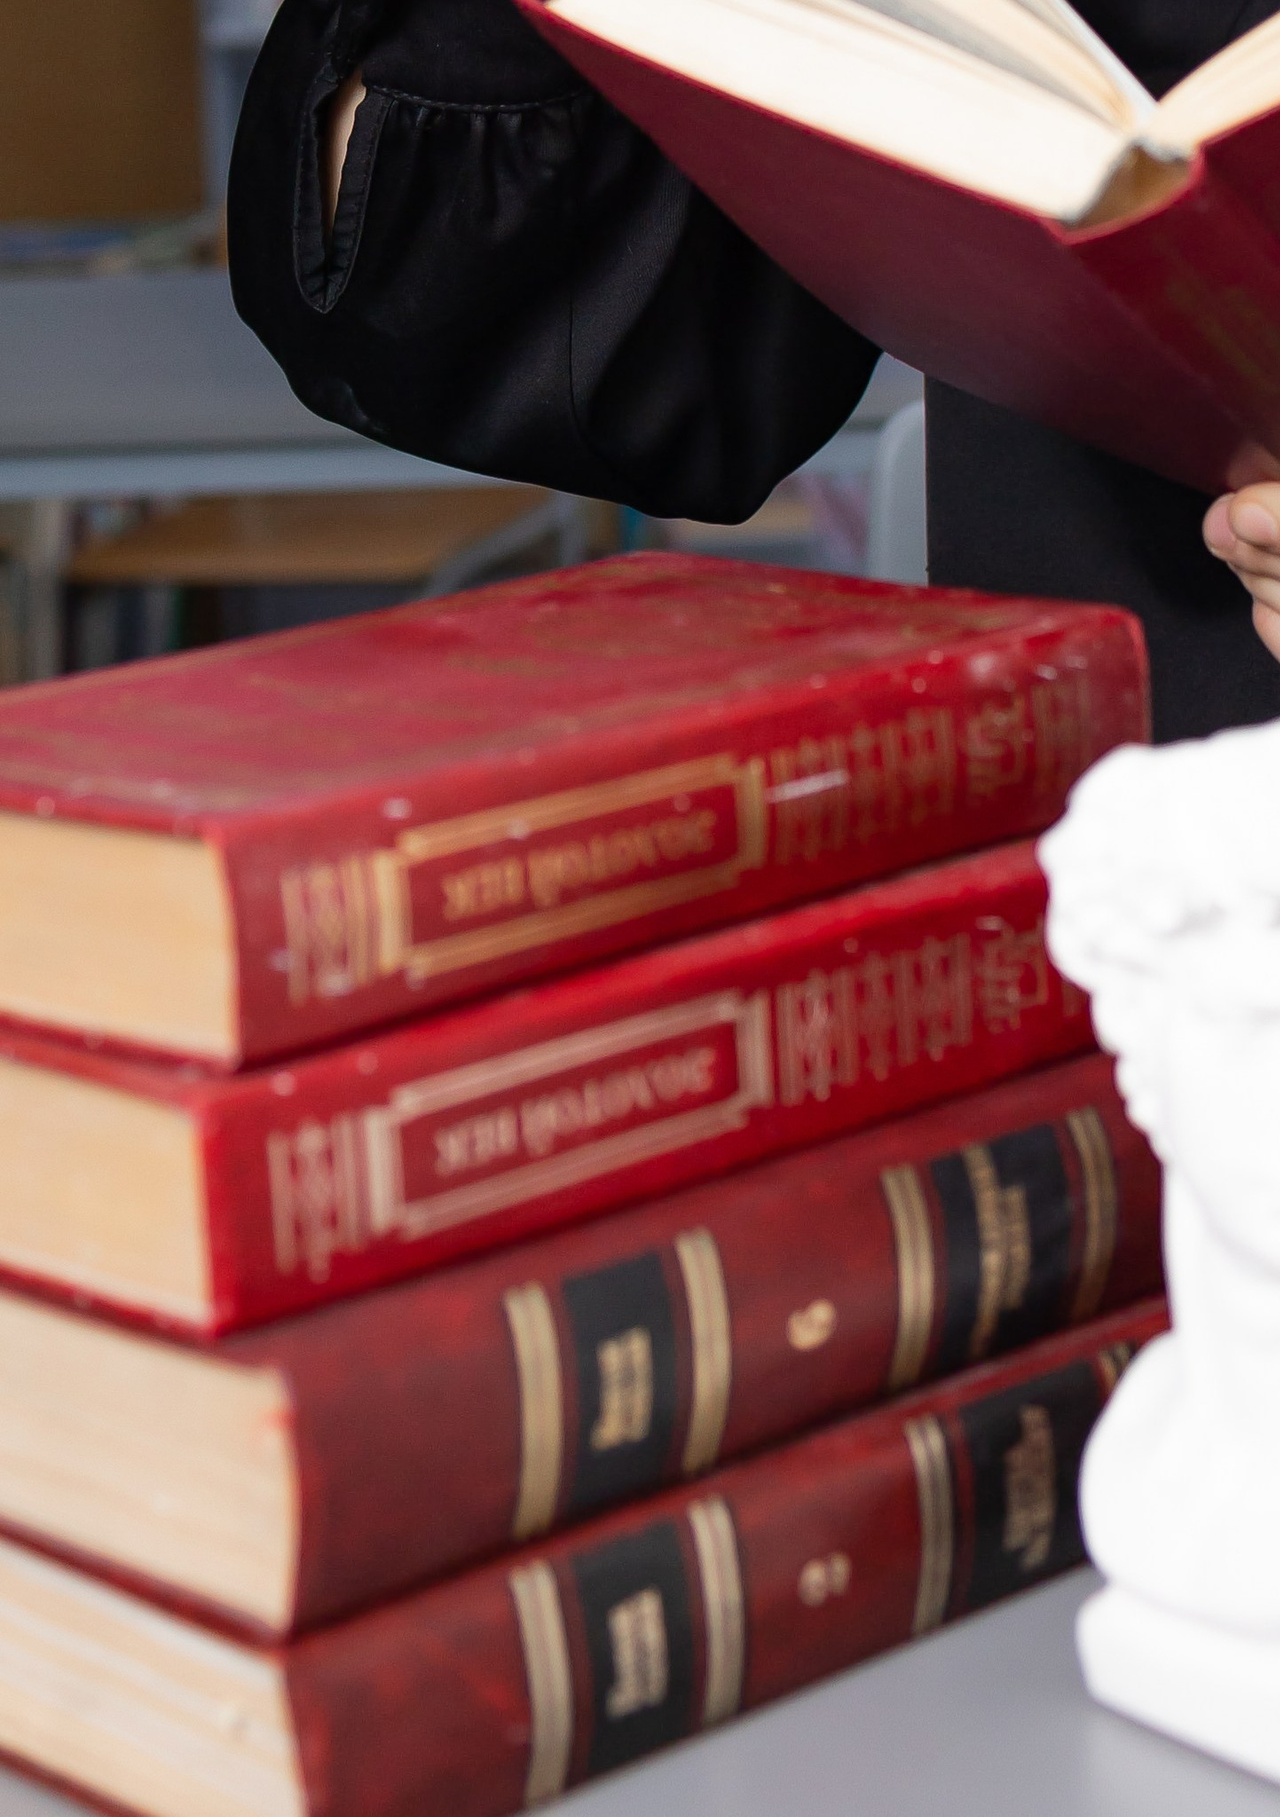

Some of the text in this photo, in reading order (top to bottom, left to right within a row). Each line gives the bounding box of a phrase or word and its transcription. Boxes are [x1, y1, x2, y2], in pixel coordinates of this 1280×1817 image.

[442, 809, 717, 922] ЗОЛОТОЙ ВЕК
[434, 1046, 717, 1177] ЗОЛОТОЙ ВЕК
